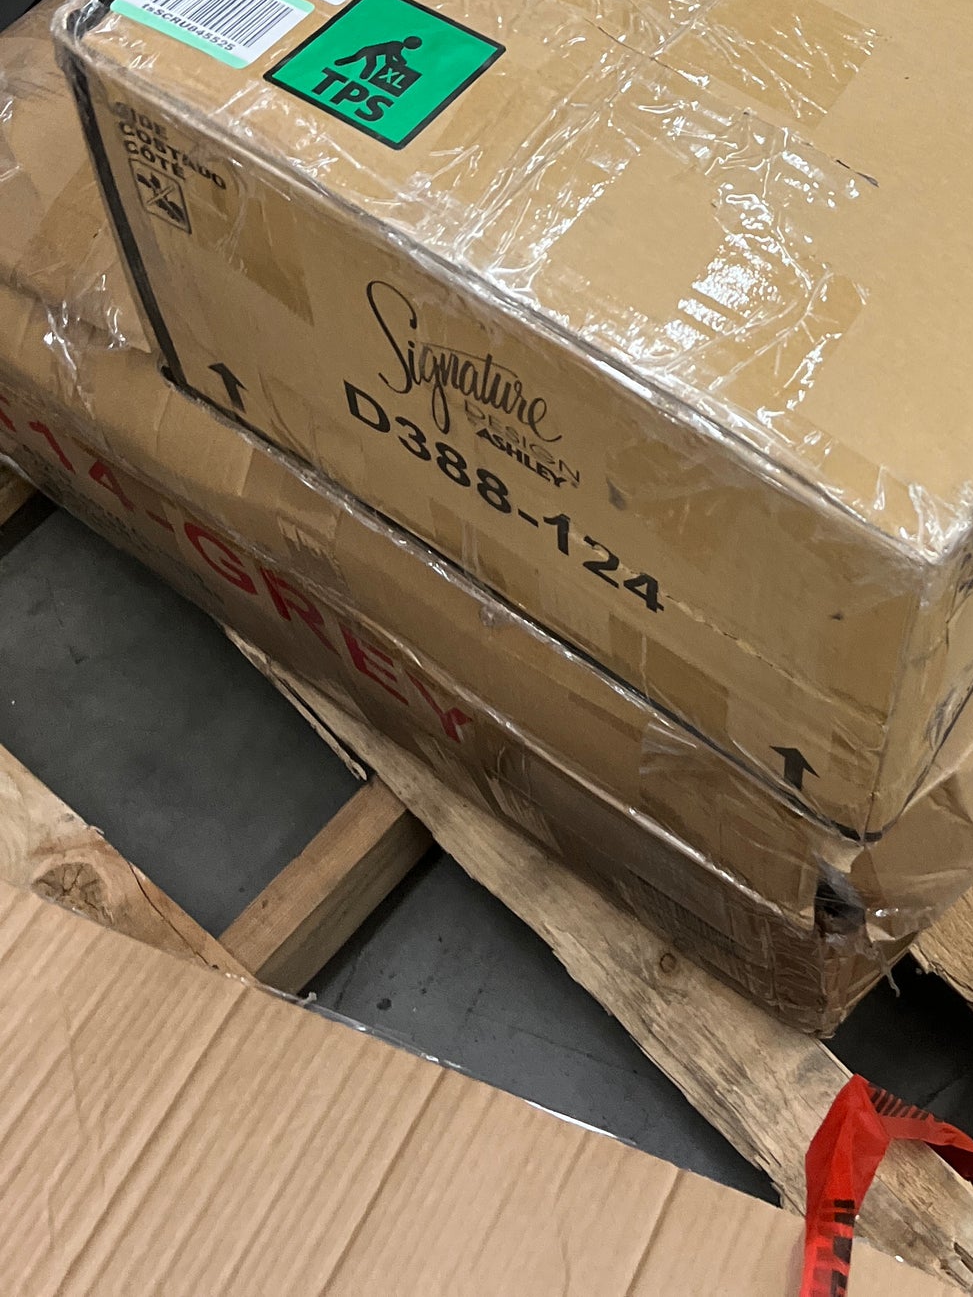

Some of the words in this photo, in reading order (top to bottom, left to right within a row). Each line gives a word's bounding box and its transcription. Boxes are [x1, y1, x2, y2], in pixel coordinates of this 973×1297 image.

[312, 67, 394, 122] TPS
[378, 68, 405, 89] XL
[366, 280, 562, 443] Signature
[464, 399, 580, 484] DESIGN
[475, 427, 568, 489] ASHLEY
[343, 379, 665, 614] D388-124
